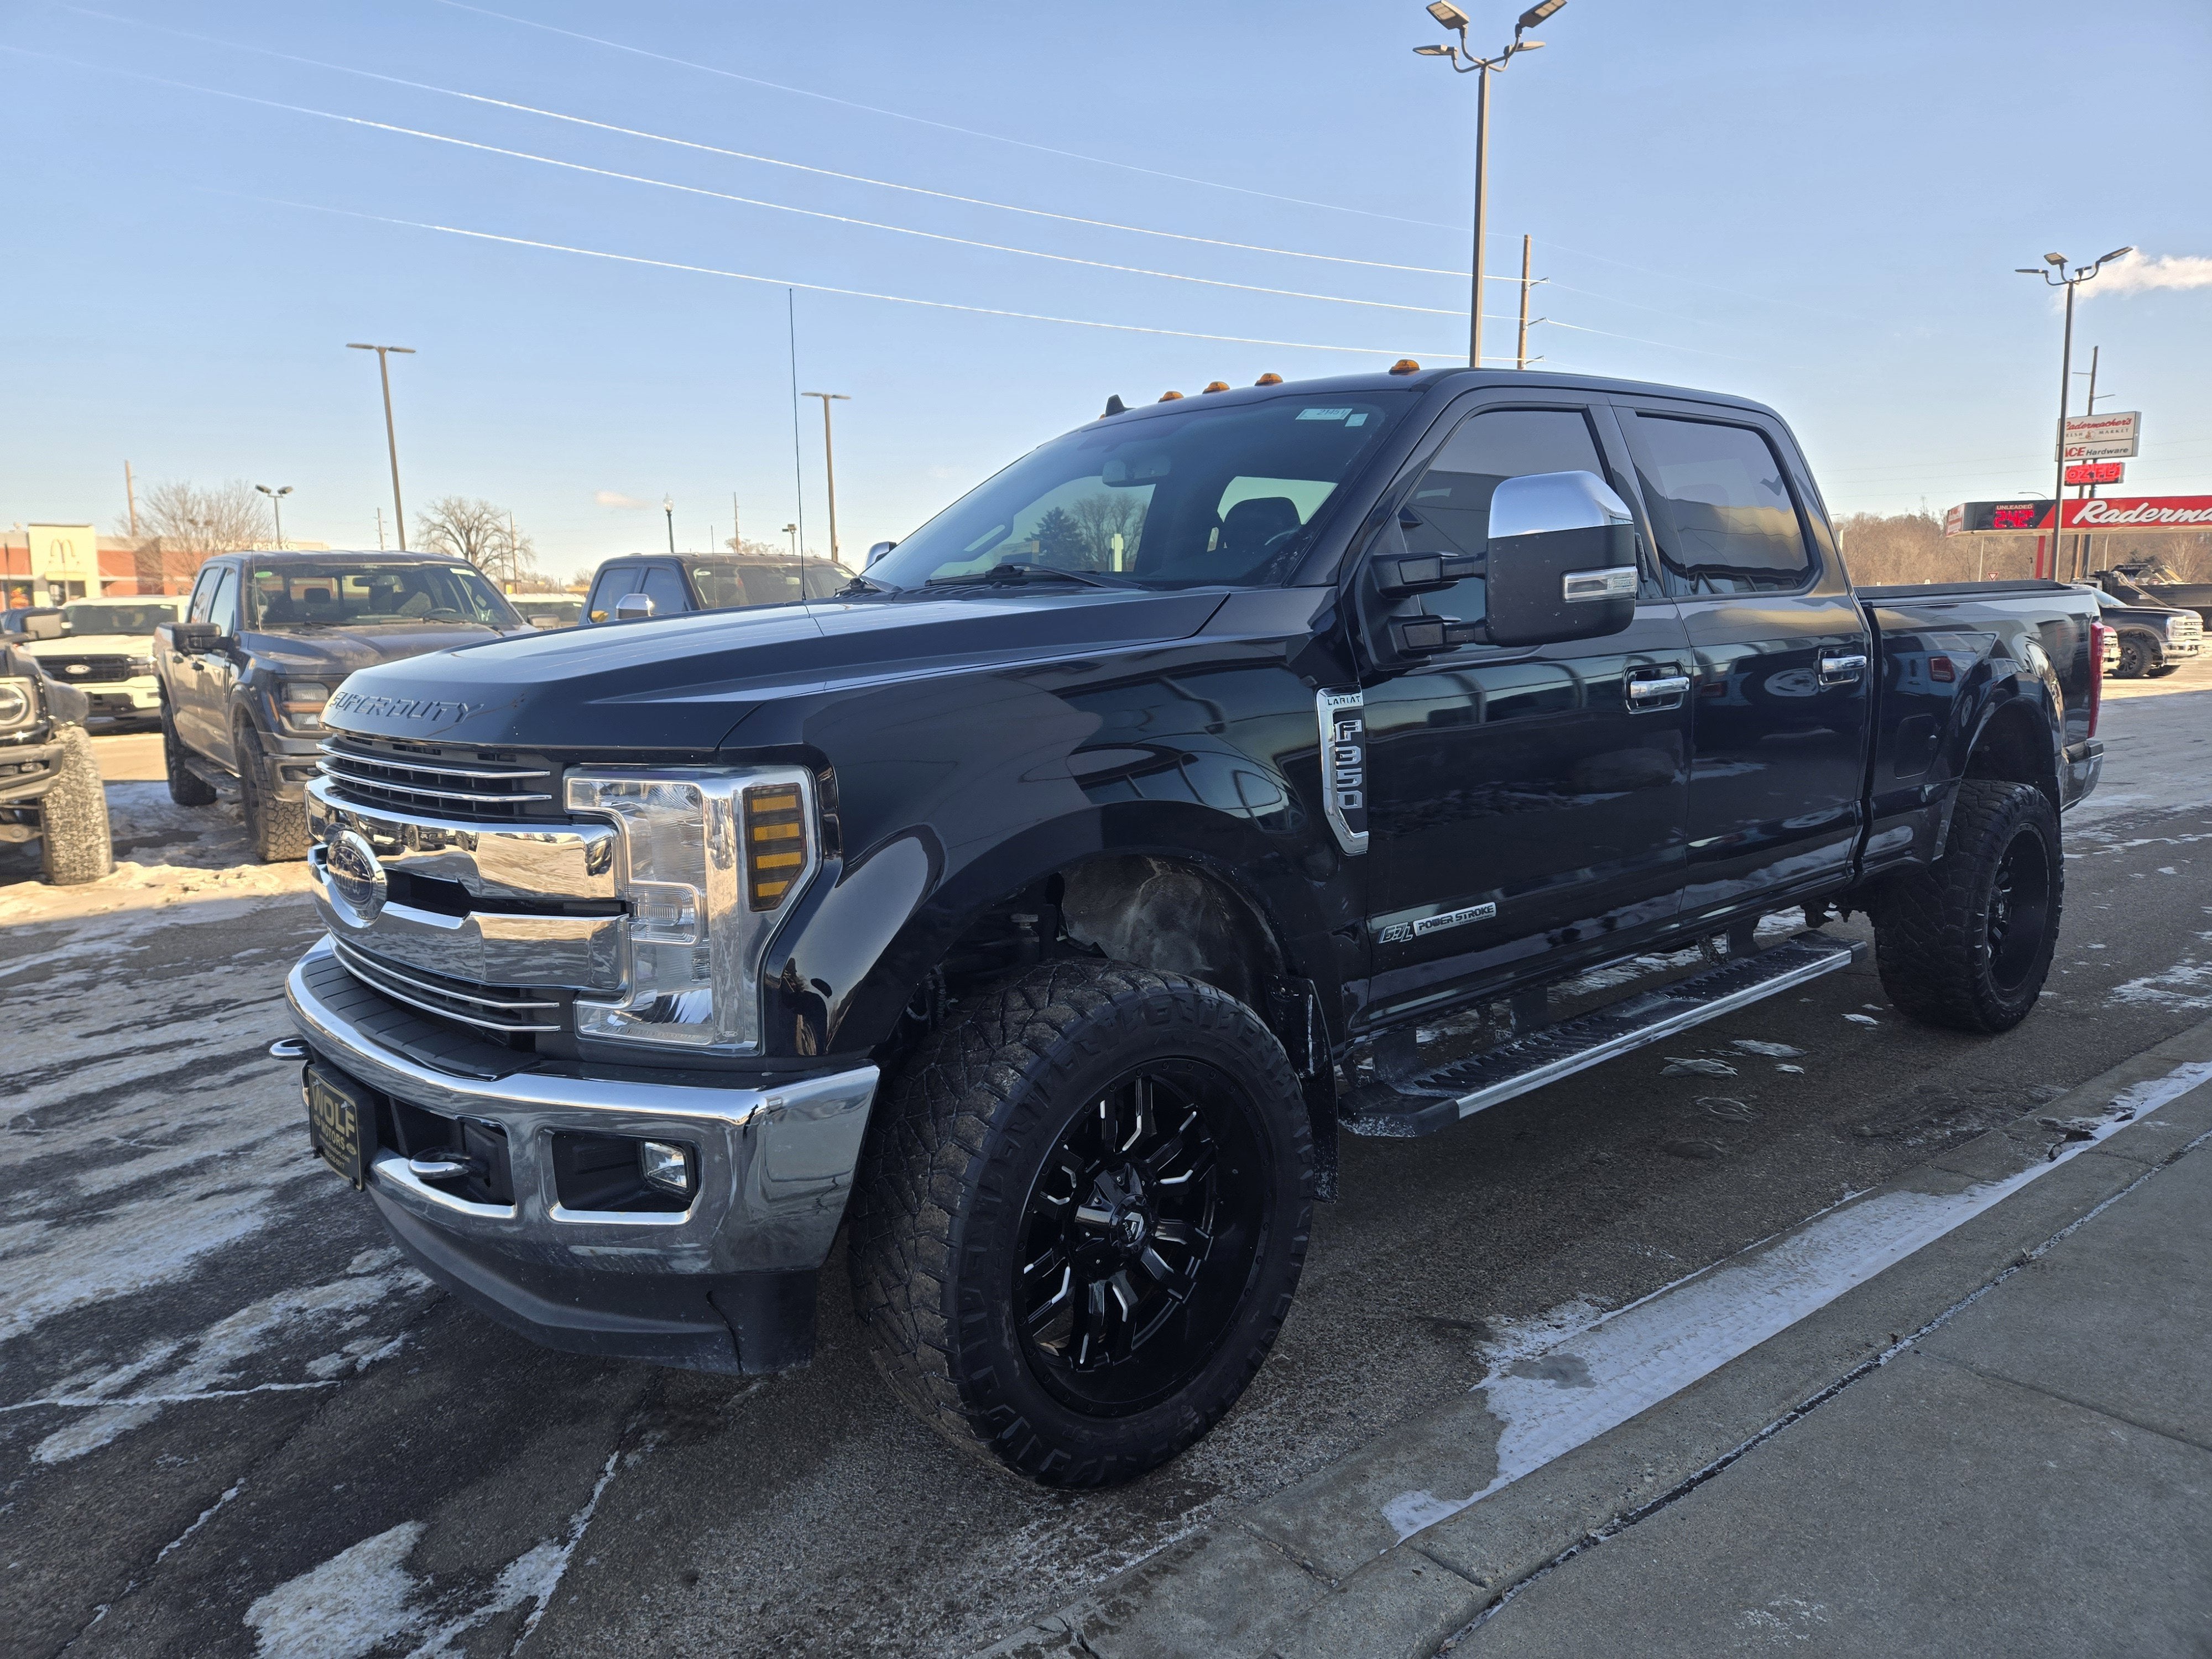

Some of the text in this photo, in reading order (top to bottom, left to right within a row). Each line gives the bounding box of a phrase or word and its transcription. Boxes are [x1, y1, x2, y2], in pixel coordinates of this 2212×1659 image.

[329, 691, 484, 724] SUPER DUTY
[1327, 695, 1360, 706] LARIAT
[1334, 719, 1363, 810] F350
[1418, 915, 1454, 931] POWER
[1455, 904, 1494, 922] STROKE
[311, 1082, 355, 1138] WOLF
[320, 1119, 345, 1150] MOTORS
